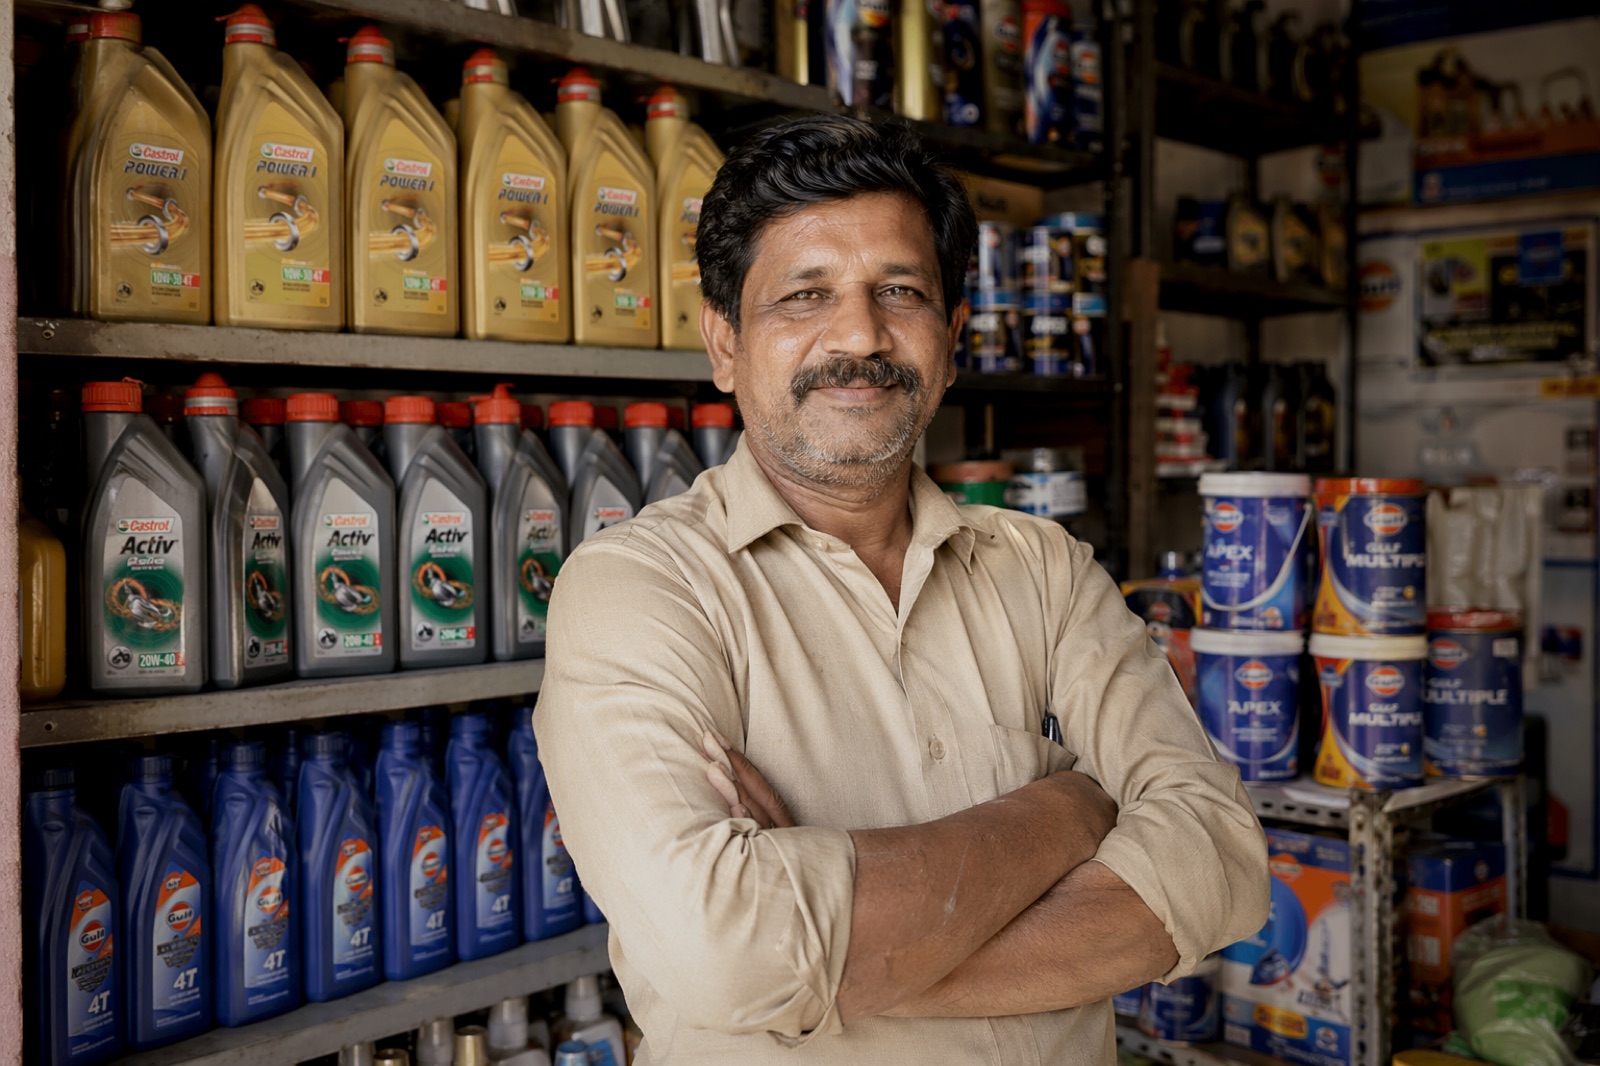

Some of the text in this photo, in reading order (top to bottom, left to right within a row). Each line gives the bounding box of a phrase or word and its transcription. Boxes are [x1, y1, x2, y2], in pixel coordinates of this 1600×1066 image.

[143, 147, 180, 161] Castrol
[274, 146, 309, 160] Castrol
[124, 160, 178, 179] POWER
[256, 160, 308, 177] POWER
[130, 520, 170, 531] Castrol
[251, 532, 281, 550] Activ
[327, 530, 372, 547] Activ
[425, 528, 468, 544] Activ
[120, 535, 175, 555] Activ
[140, 653, 176, 667] 20W-40
[1424, 689, 1508, 705] ULTIPLE
[1228, 700, 1281, 716] APEX
[168, 909, 193, 923] Gulf
[426, 910, 446, 929] 4T
[81, 927, 105, 945] Gulf
[351, 926, 371, 947] 4T
[263, 949, 286, 970] 4T
[173, 967, 198, 990] 4T
[88, 990, 110, 1014] 4T
